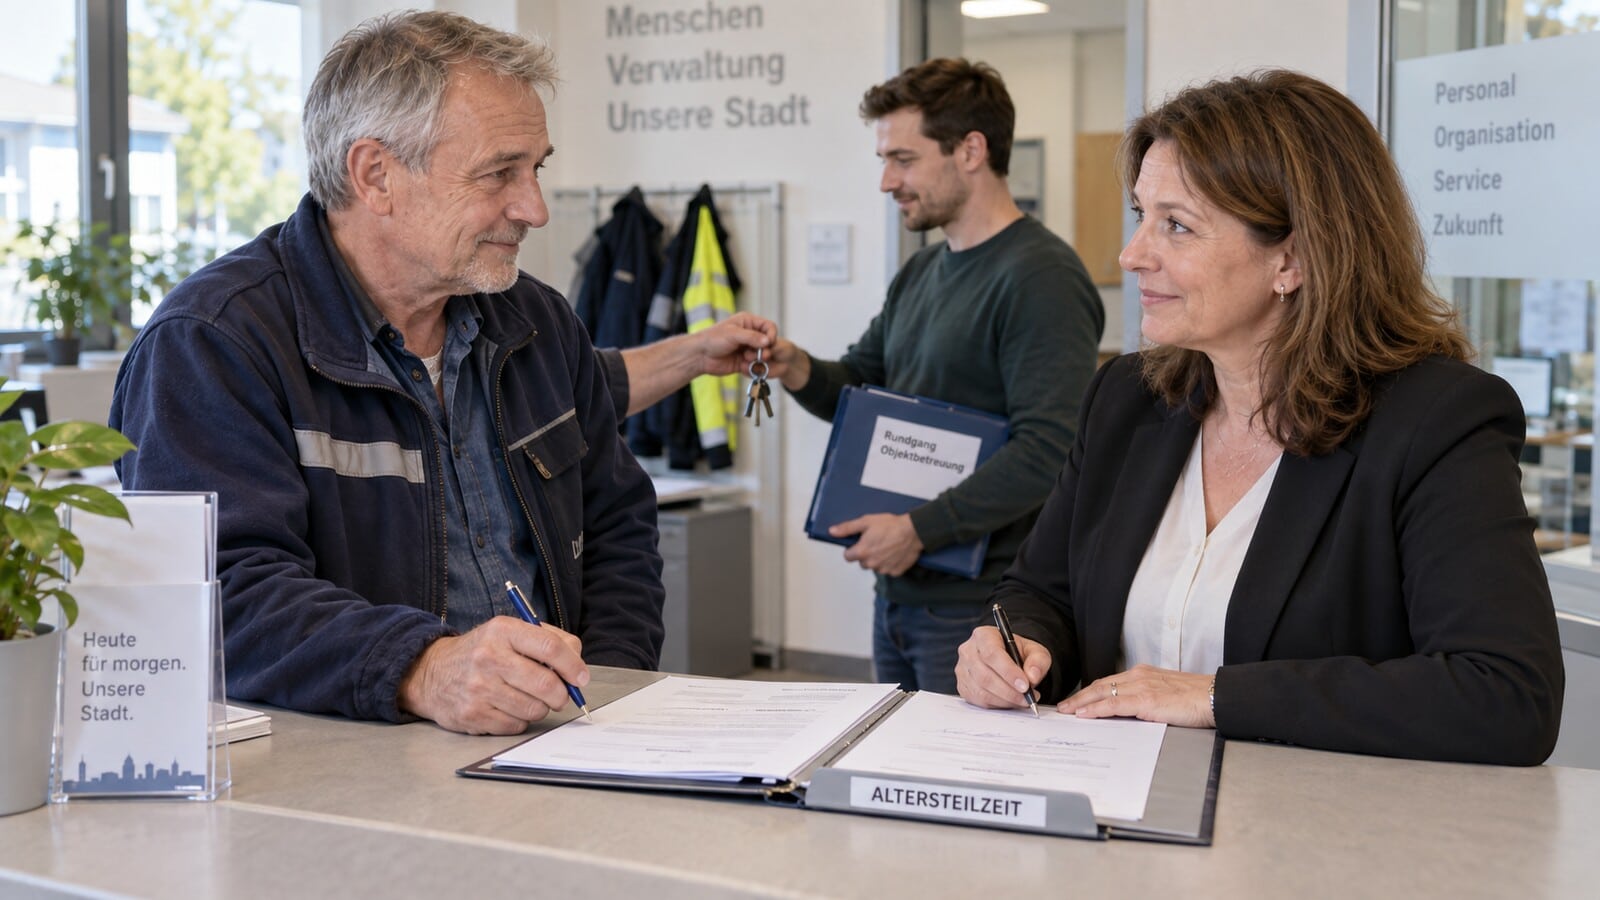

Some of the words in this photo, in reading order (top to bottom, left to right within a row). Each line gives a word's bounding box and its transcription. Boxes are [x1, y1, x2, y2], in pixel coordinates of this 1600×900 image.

[606, 0, 763, 38] Menschen
[606, 49, 785, 86] Verwaltung
[1435, 73, 1516, 104] Personal
[606, 102, 713, 132] Unsere
[724, 94, 810, 129] Stadt
[1435, 119, 1555, 151] Organisation
[1433, 168, 1503, 192] Service
[1433, 212, 1504, 236] Zukunft
[884, 430, 937, 452] Rundgang
[880, 445, 965, 473] Objektbetreuung
[83, 632, 136, 648] Heute
[82, 655, 107, 672] für
[112, 658, 187, 674] morgen.
[82, 681, 146, 697] Unsere
[80, 705, 134, 721] Stadt.
[871, 786, 1022, 817] ALTERSTEILZEIT
